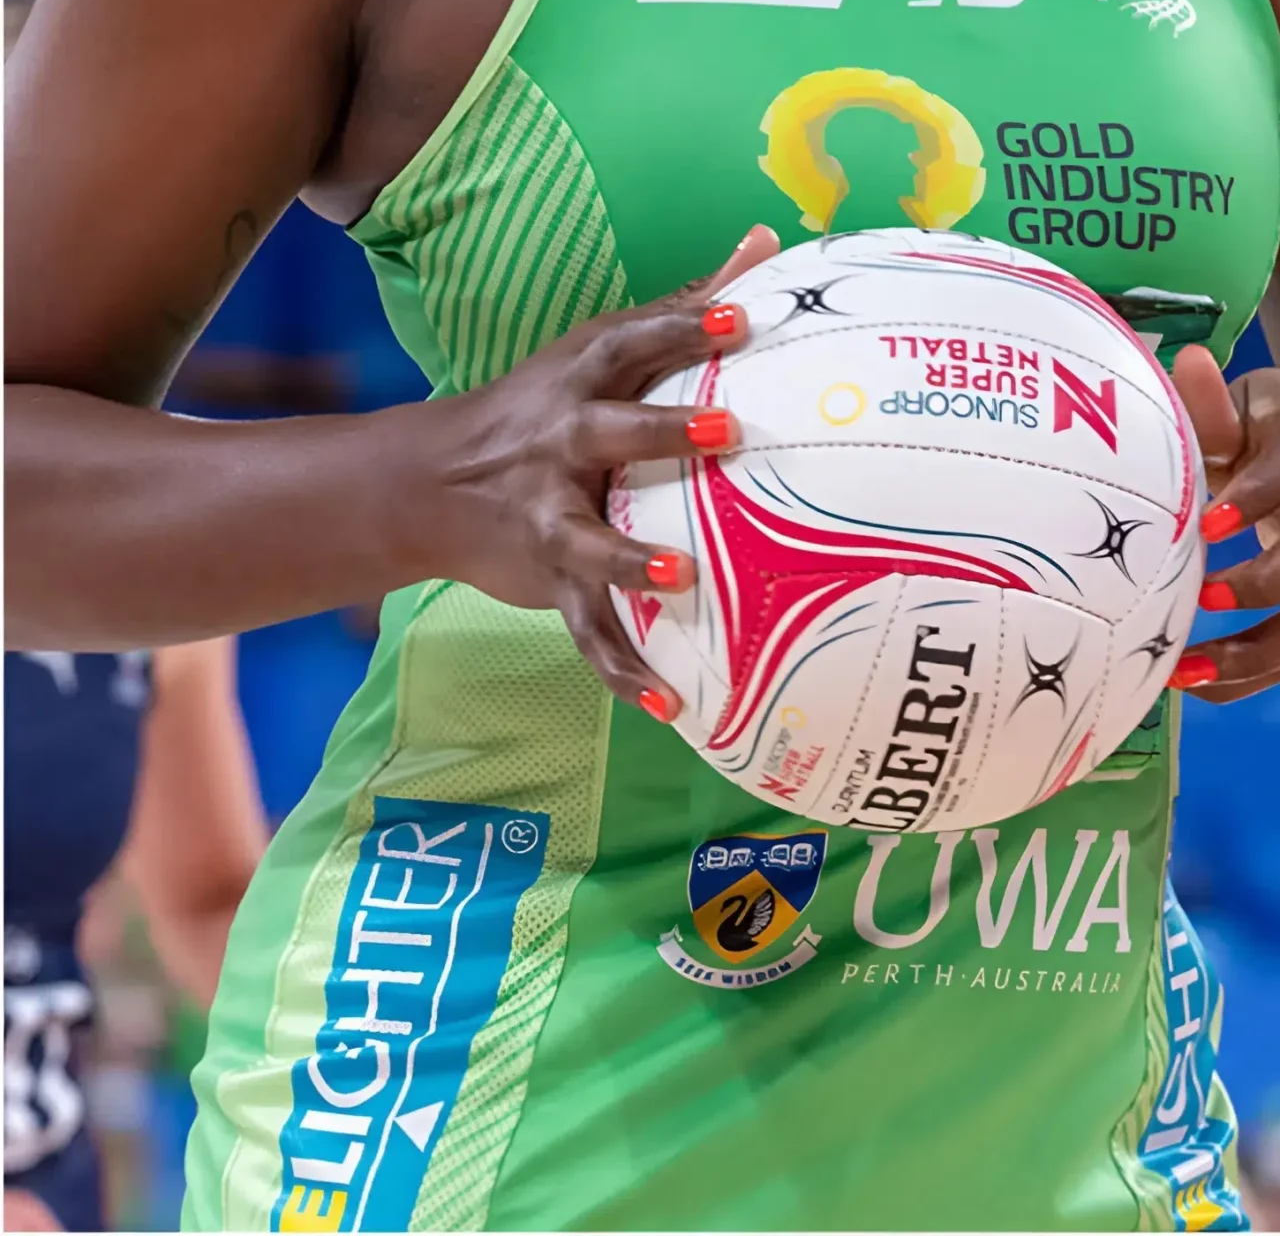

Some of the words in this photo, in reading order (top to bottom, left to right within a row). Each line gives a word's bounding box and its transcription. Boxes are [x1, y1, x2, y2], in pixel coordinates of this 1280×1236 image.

[997, 122, 1134, 159] GOLD
[1003, 163, 1235, 215] INDUSTRY
[1008, 207, 1176, 252] GROUP
[878, 336, 1040, 372] NETBALL
[925, 364, 1040, 400] SUPER
[880, 391, 1040, 428] SUNCORP
[853, 828, 1132, 952] UWA
